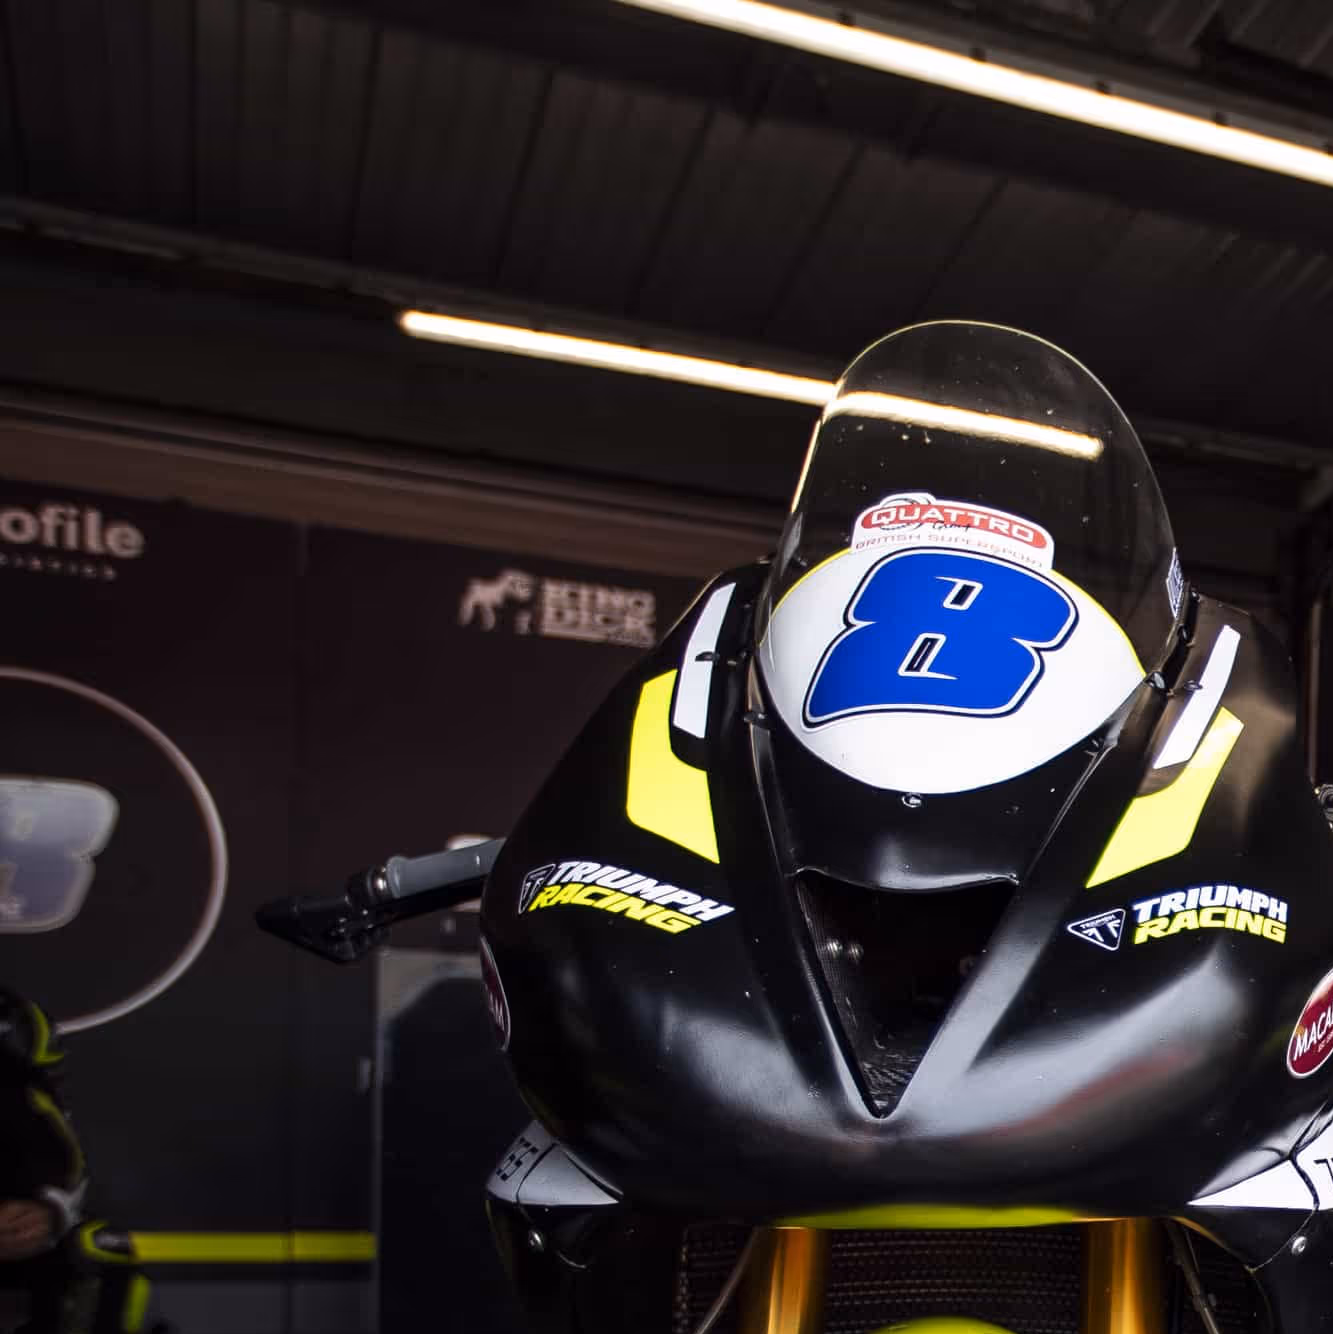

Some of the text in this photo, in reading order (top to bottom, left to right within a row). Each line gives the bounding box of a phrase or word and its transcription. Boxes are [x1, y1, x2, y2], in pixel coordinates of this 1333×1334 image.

[870, 507, 1035, 543] QUATTRO
[804, 546, 1079, 731] 8
[528, 883, 702, 934] RACING
[546, 861, 736, 921] TRIUMPH
[1133, 886, 1288, 923] TRIUMPH
[1134, 907, 1287, 944] RACING
